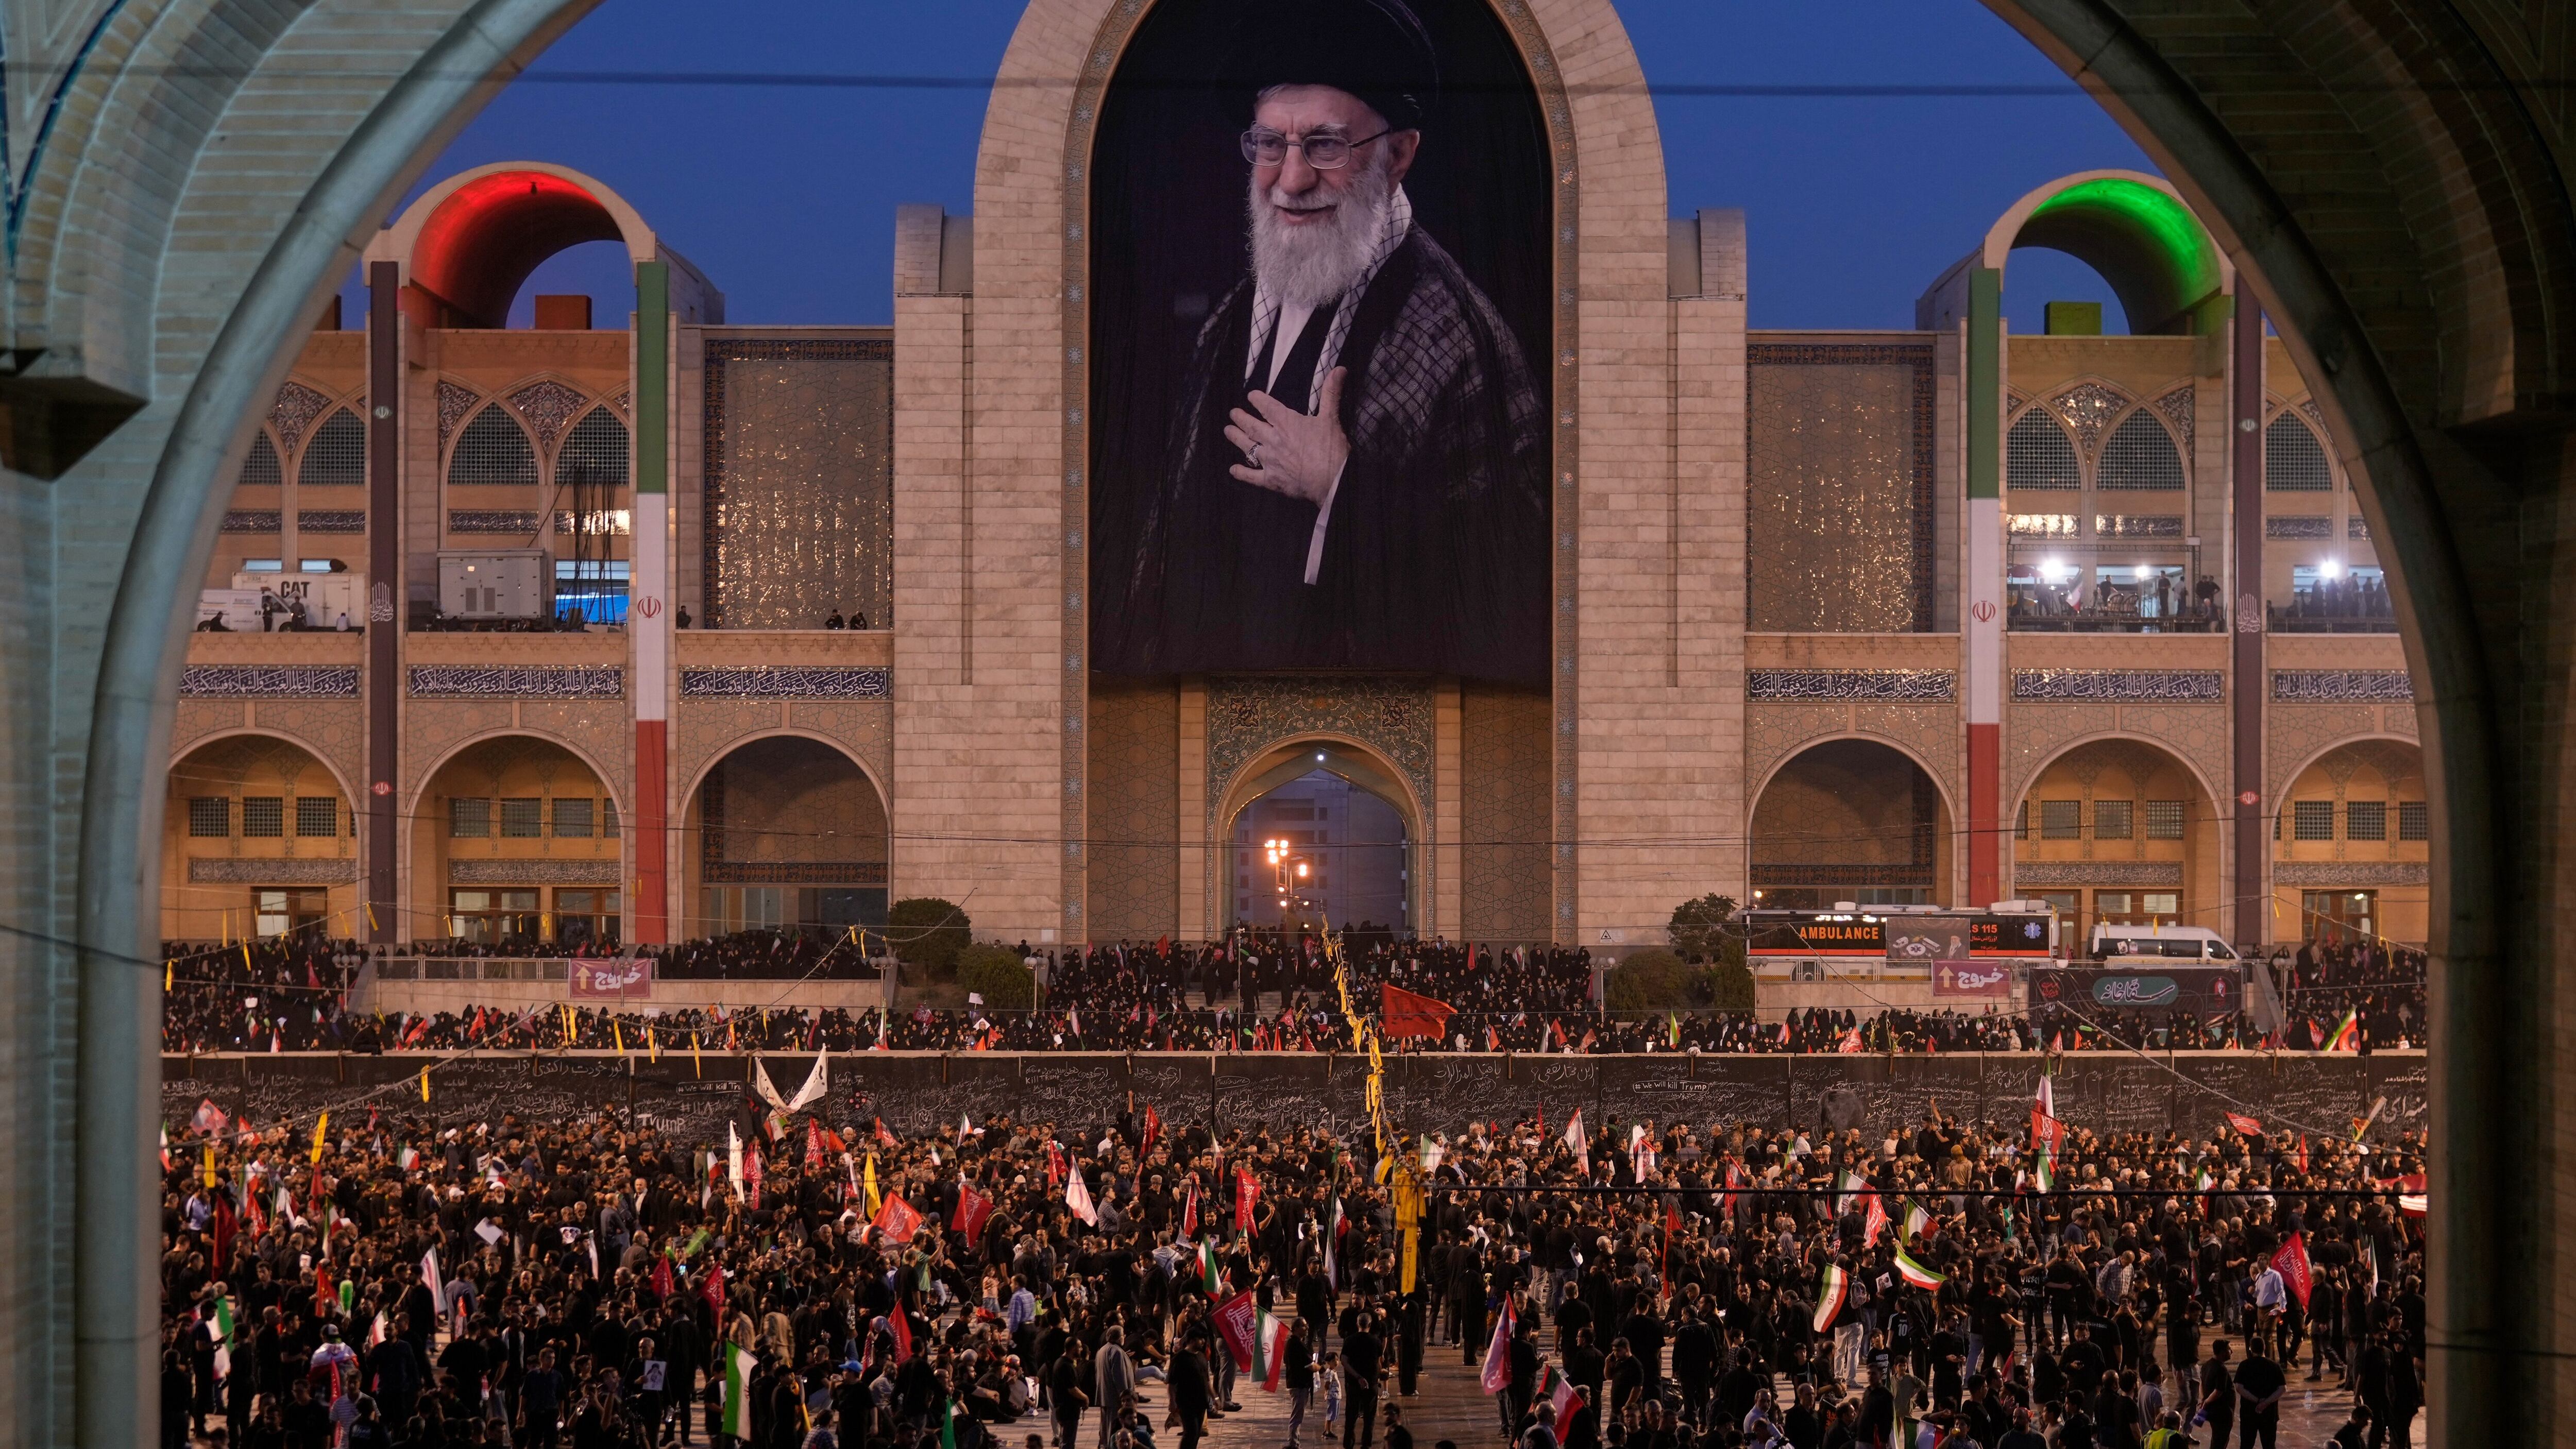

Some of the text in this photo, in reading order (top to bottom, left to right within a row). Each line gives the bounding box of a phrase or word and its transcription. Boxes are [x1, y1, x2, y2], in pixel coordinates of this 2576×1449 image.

[281, 581, 310, 598] CAT
[1800, 927, 1878, 939] AMBULANCE
[1970, 924, 1997, 933] S 115
[595, 966, 641, 990] خروج
[1958, 967, 2003, 988] خروج
[572, 1061, 607, 1077] خودت
[728, 1082, 742, 1091] Tru
[1680, 1082, 1707, 1090] Trump
[1898, 1323, 1908, 1336] 10
